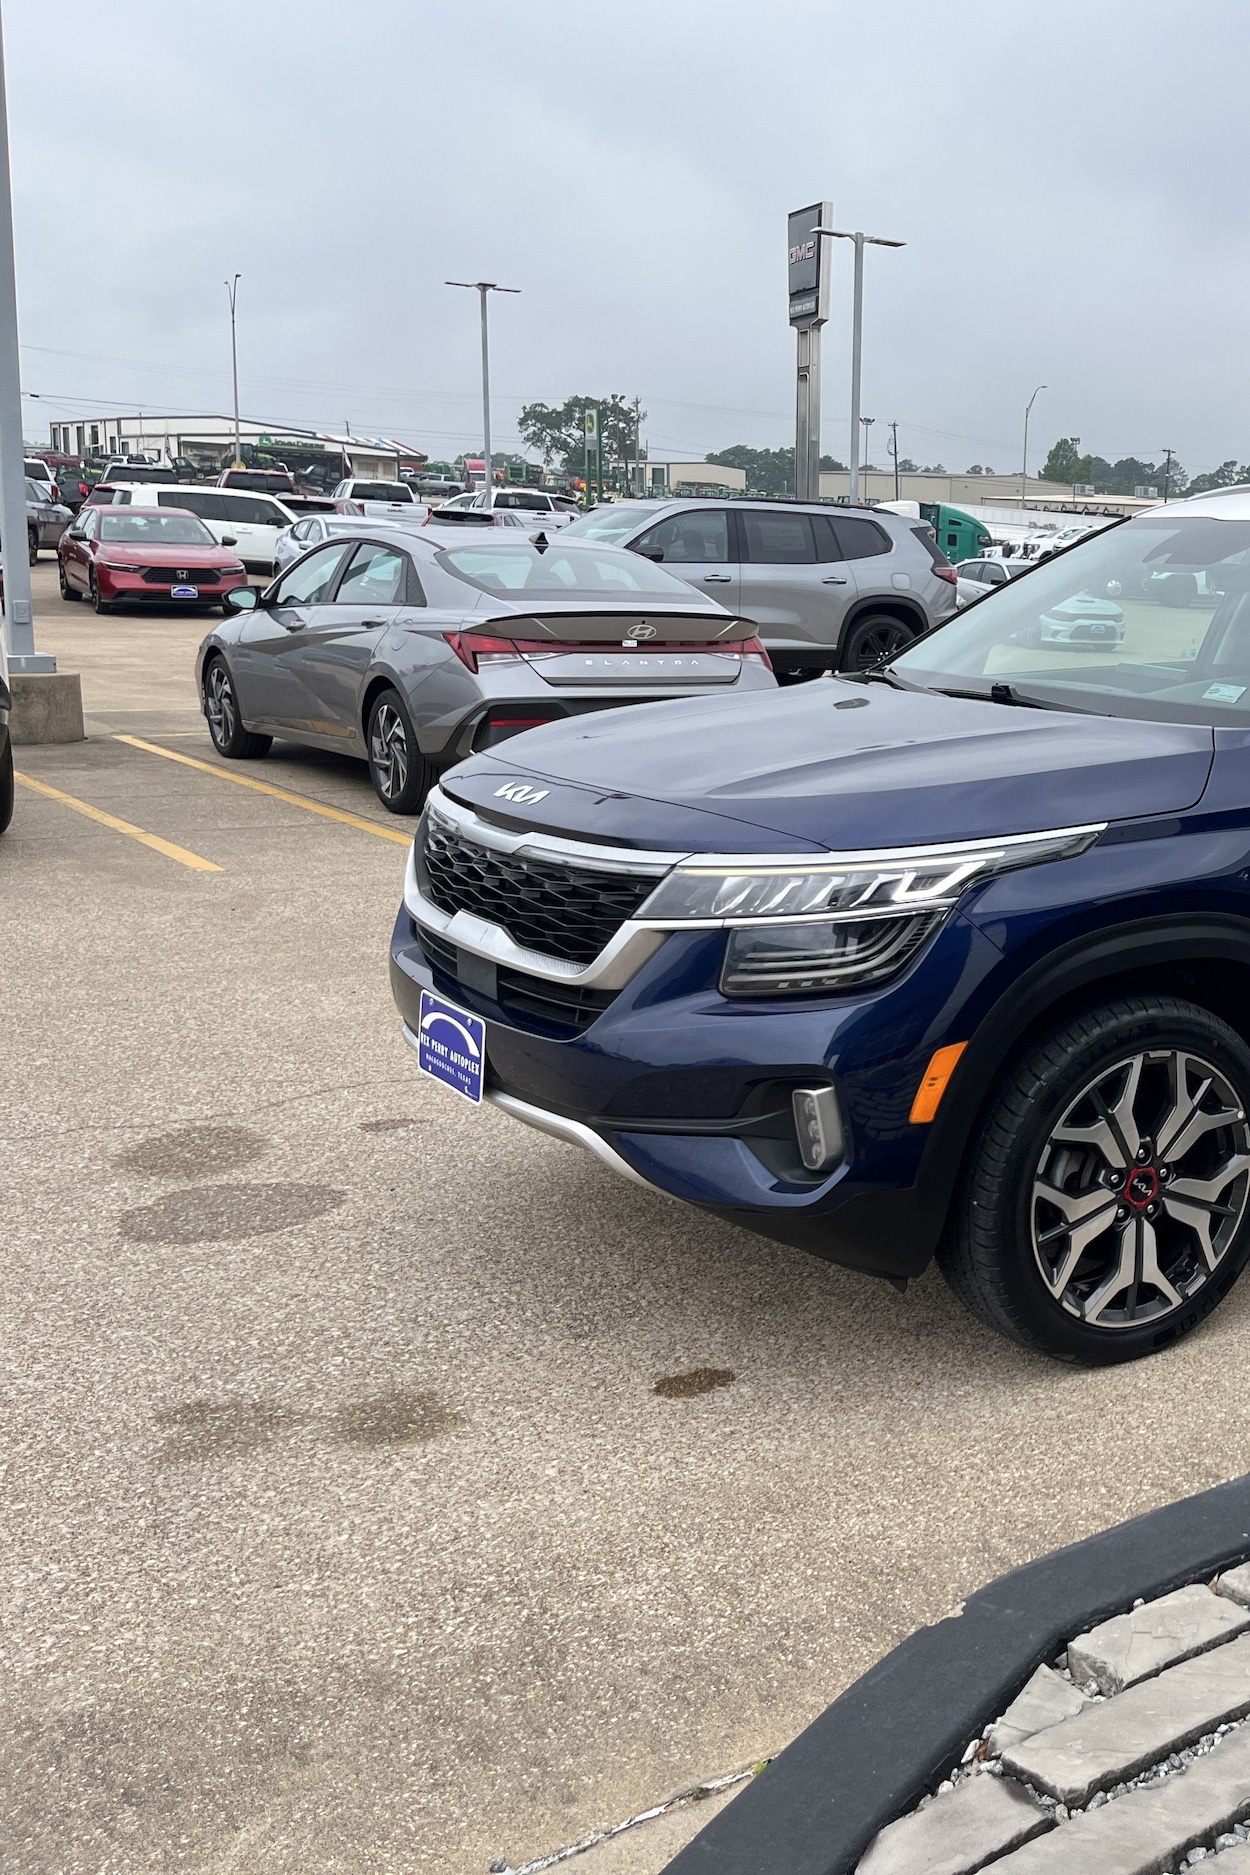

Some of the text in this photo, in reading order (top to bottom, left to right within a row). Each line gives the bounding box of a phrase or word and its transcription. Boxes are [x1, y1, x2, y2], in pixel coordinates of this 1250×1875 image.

[789, 241, 815, 265] GMC
[493, 781, 551, 806] KIA
[431, 1038, 449, 1058] PERRY
[450, 1050, 480, 1076] AUTOPLEX
